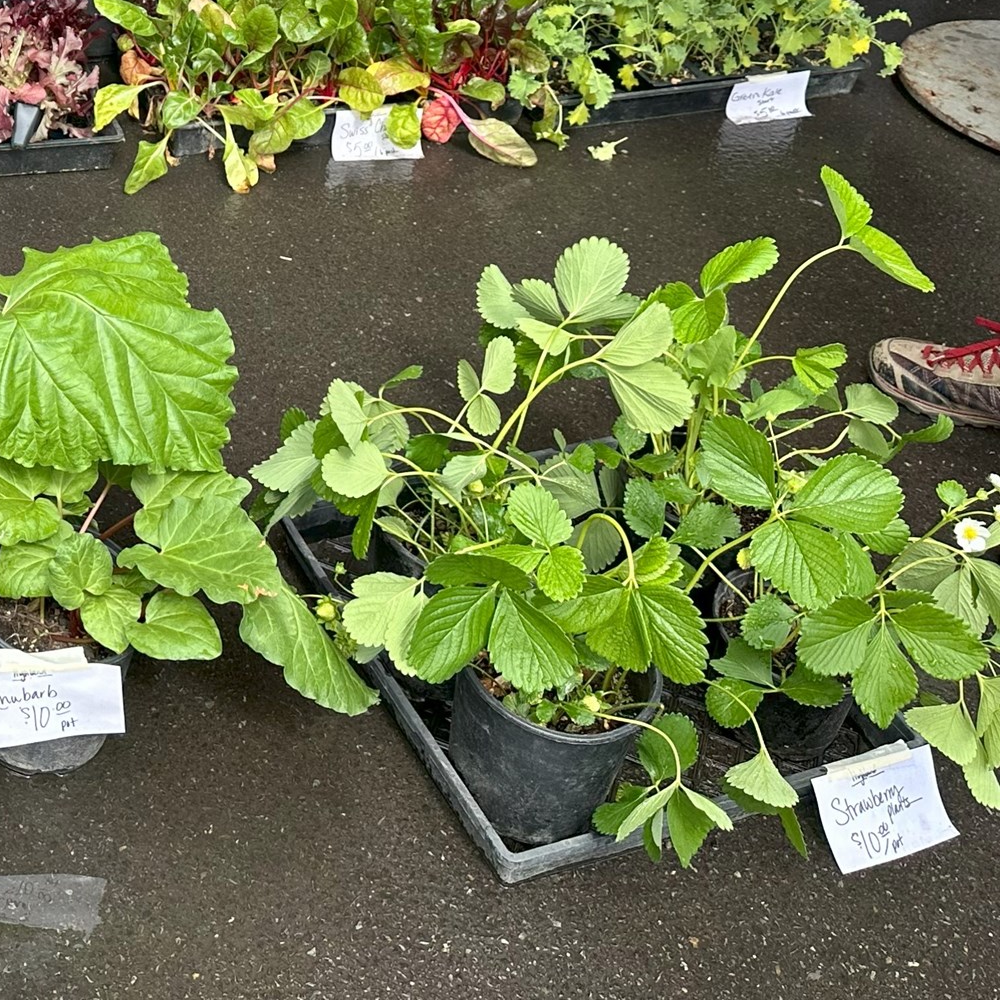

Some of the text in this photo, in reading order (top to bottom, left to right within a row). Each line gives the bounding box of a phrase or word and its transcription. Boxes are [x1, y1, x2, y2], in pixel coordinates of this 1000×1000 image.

[731, 87, 782, 103] Green Kale
[340, 122, 369, 140] Swiss
[61, 717, 79, 732] pot
[830, 784, 905, 827] Strawberry
[887, 796, 924, 825] plants
